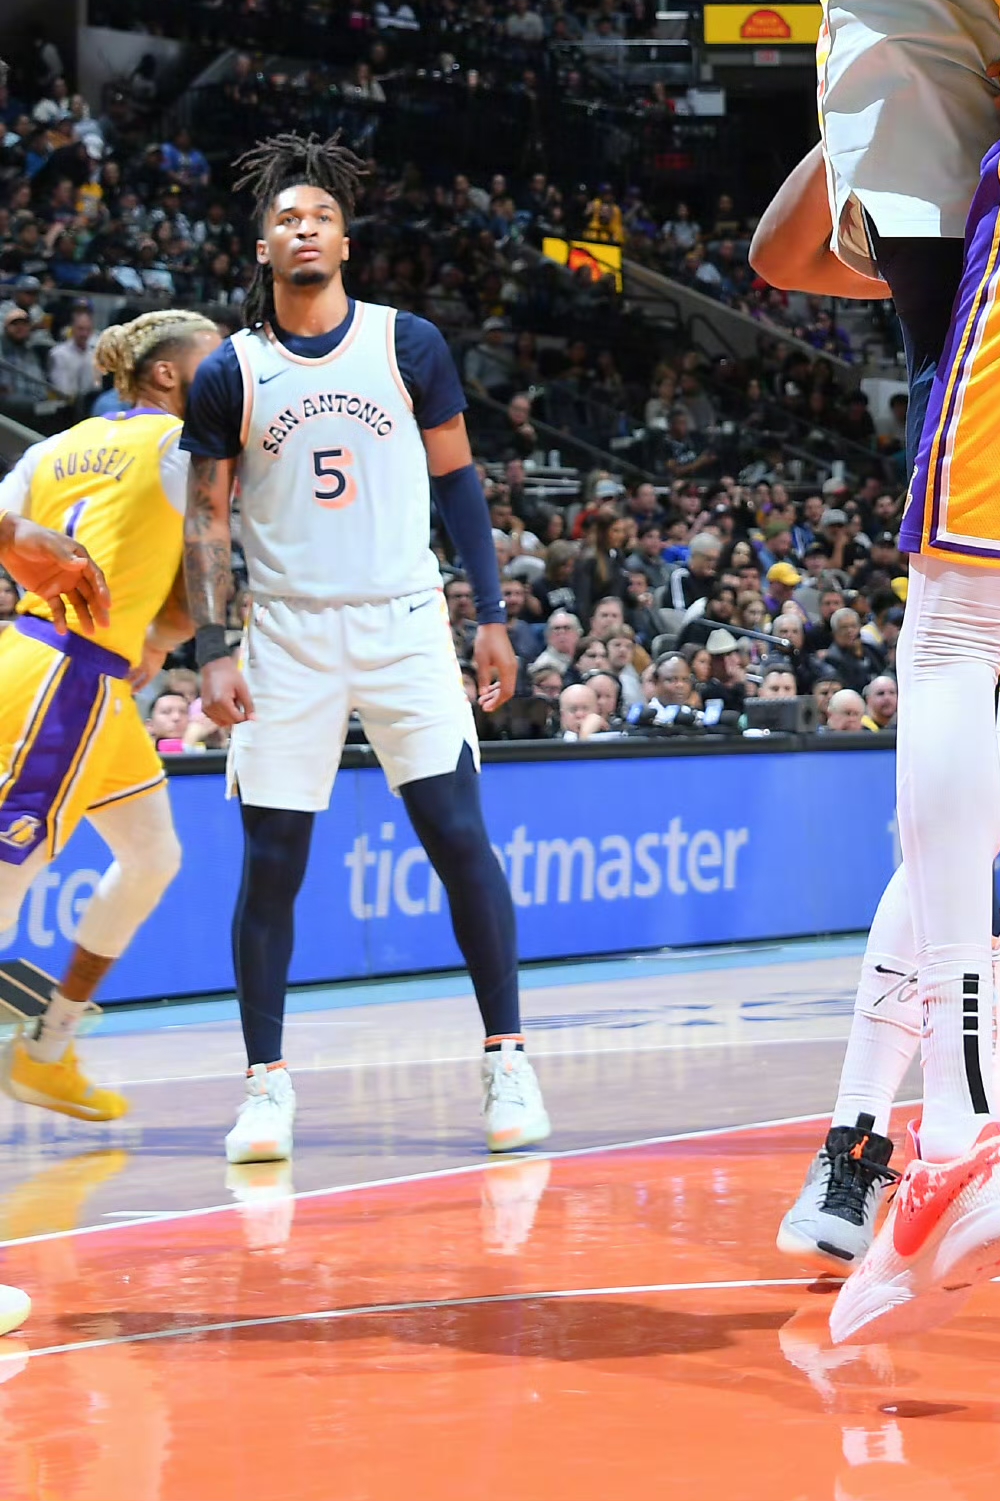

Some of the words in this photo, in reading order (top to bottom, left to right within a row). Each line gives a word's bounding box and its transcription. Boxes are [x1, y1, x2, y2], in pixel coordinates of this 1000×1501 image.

[263, 410, 300, 454] SAN
[303, 394, 392, 436] ANTONIO
[54, 447, 135, 482] RUSSELL
[312, 448, 350, 502] 5
[63, 497, 90, 540] 1
[344, 815, 749, 921] tictmaster
